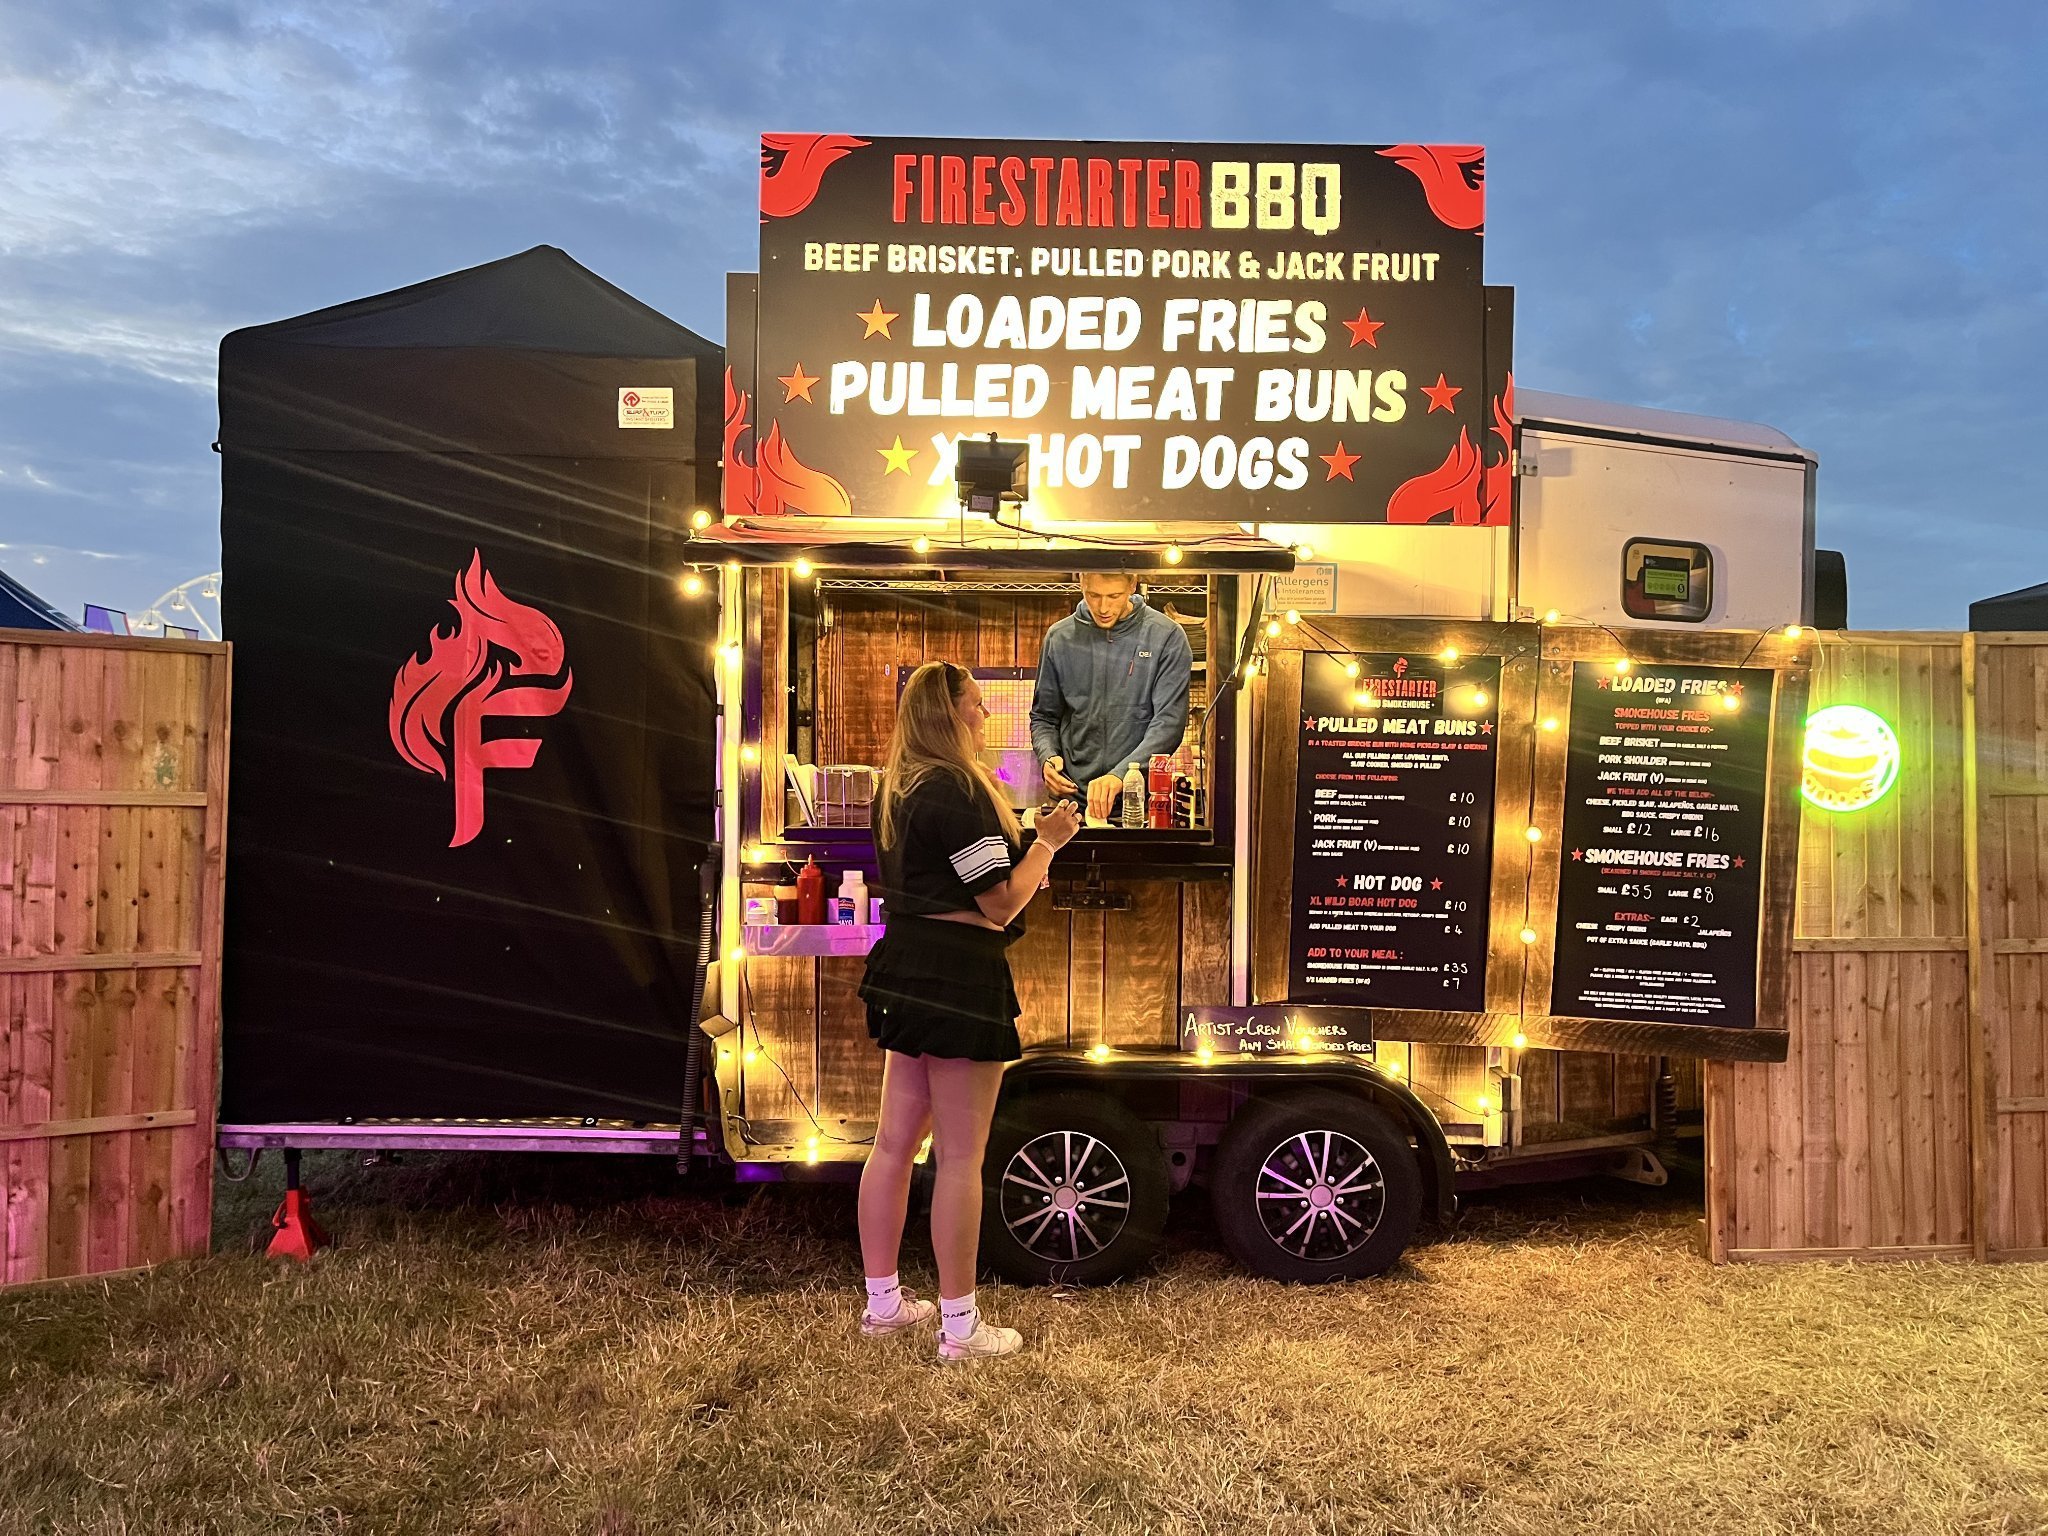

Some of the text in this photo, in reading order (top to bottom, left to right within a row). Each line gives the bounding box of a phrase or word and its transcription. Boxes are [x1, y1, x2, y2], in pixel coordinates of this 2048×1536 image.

[893, 154, 1341, 236] FIRESTARTER BBQ
[804, 242, 880, 272] BEEF
[1031, 247, 1144, 277] PULLED
[1151, 249, 1232, 279] PORK
[1238, 251, 1261, 280] &
[1267, 251, 1344, 281] JACK
[1352, 252, 1440, 281] FRUIT
[912, 293, 1327, 353] LOADED FRIES
[830, 361, 1407, 423] PULLED MEAT BUNS
[1027, 433, 1142, 489] HOT
[1162, 435, 1309, 491] DOGS
[1276, 577, 1329, 588] Allergens
[1363, 678, 1437, 698] FIRESTARTER
[1611, 676, 1676, 694] LOADED
[1381, 699, 1431, 709] SMOKEHOUSE
[1614, 707, 1711, 722] SMOKEHOUSE FRIES
[1318, 716, 1477, 736] PULLED MEAT BUNS
[1599, 735, 1623, 746] BEEF
[1623, 736, 1661, 748] BRISKET
[1598, 753, 1622, 764] PORK
[1623, 755, 1668, 766] SHOULDER
[1597, 771, 1622, 781] JACK
[1622, 772, 1648, 783] FRUIT
[1649, 772, 1664, 785] (V)
[1315, 788, 1338, 799] BEEF
[1313, 813, 1338, 823] PORK
[1602, 825, 1623, 834] SMALL
[1311, 839, 1336, 849] JACK
[1336, 839, 1362, 850] FRUIT
[1363, 838, 1378, 852] (V)
[1584, 848, 1730, 870] SMOKEHOUSE FRIES
[1353, 874, 1423, 892] HOT DOG
[1597, 886, 1618, 894] SMALL
[1309, 896, 1418, 908] XL WILD BOAR HOT DOG
[1660, 915, 1678, 923] EACH
[1307, 947, 1327, 957] ADD
[1329, 948, 1342, 958] TO
[1344, 948, 1369, 959] YOUR
[1346, 1041, 1372, 1052] FRIES
